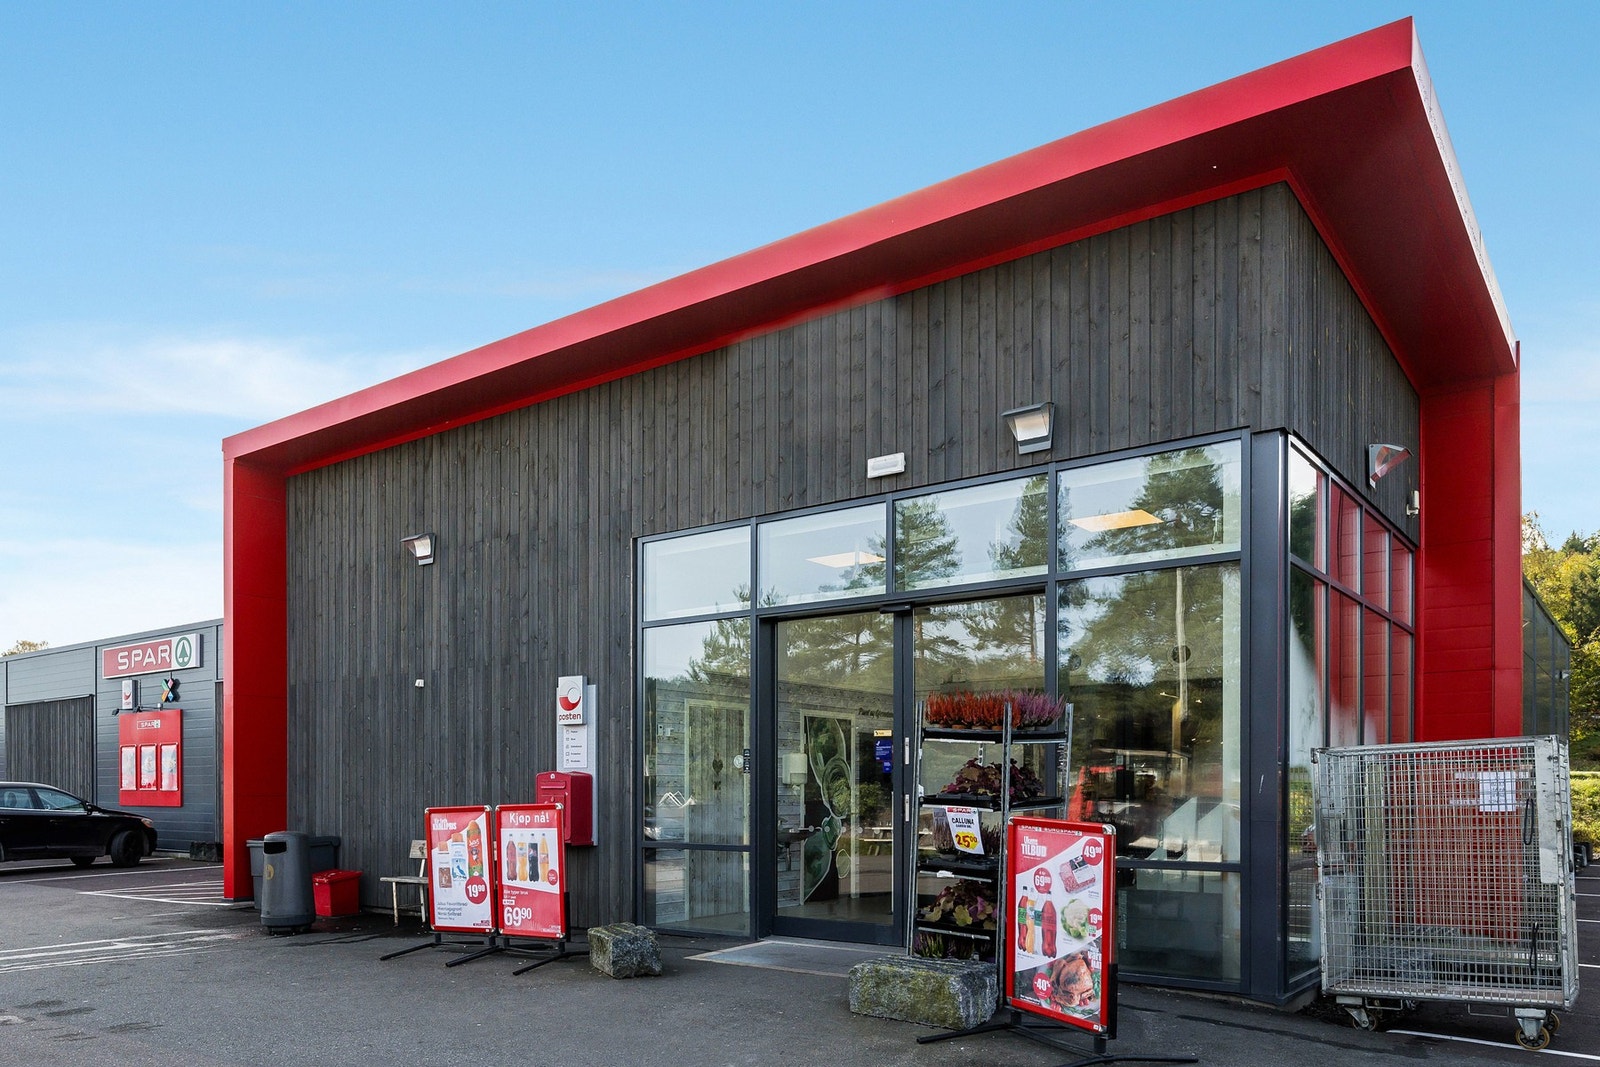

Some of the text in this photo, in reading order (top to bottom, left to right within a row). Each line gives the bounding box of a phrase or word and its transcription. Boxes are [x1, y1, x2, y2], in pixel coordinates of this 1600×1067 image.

[118, 645, 170, 669] SPAR
[558, 713, 581, 721] posten
[509, 811, 550, 826] Kjøp nå!
[951, 817, 975, 826] CALLUNA
[1021, 843, 1047, 858] TILBUD
